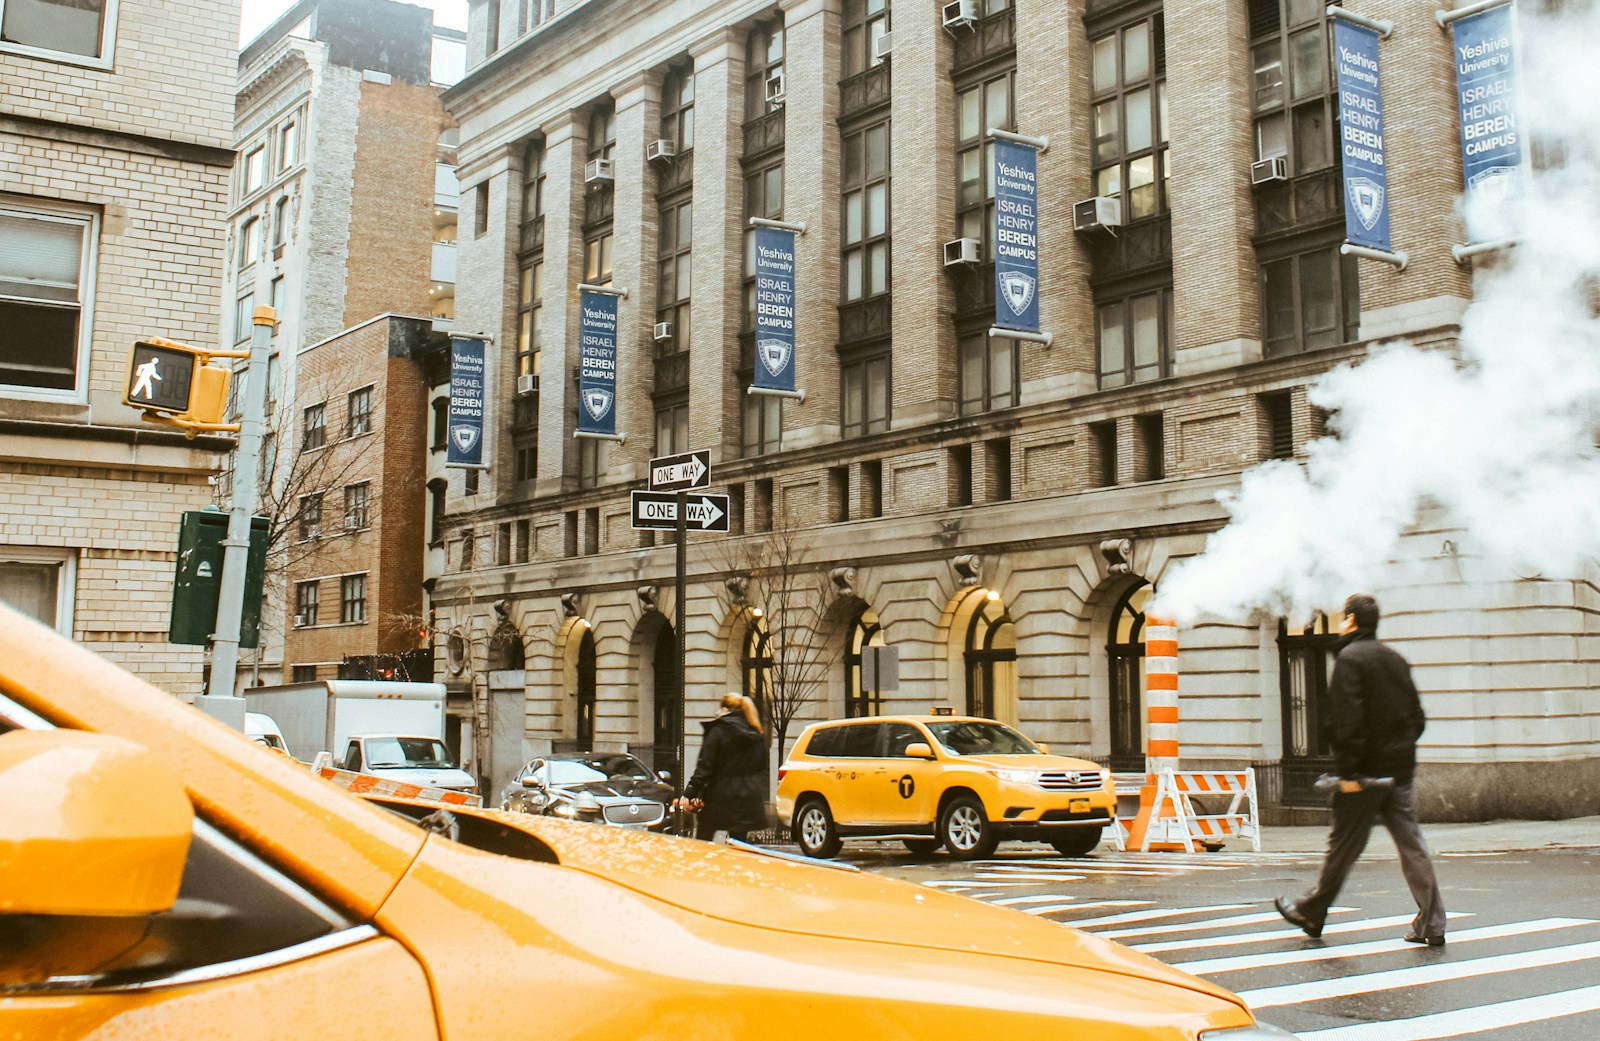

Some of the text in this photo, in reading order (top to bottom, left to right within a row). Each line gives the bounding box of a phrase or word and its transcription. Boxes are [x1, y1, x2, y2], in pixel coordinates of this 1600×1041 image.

[1459, 37, 1509, 60] Yeshiva
[1340, 46, 1378, 71] Yeshiva
[1460, 53, 1509, 74] University
[1340, 64, 1378, 87] University
[1462, 80, 1512, 104] ISRAEL
[1342, 91, 1380, 114] ISRAEL
[1463, 97, 1510, 122] HENRY
[1343, 108, 1379, 130] HENRY
[1465, 114, 1514, 140] BEREN
[1344, 126, 1382, 149] BEREN
[1466, 133, 1516, 156] CAMPUS
[1345, 145, 1383, 165] CAMPUS
[998, 163, 1034, 181] Yeshiva
[998, 177, 1034, 194] University
[998, 200, 1034, 217] ISRAEL
[998, 214, 1034, 231] HENRY
[999, 229, 1035, 247] BEREN
[758, 246, 792, 261] Yeshiva
[999, 245, 1036, 260] CAMPUS
[758, 258, 792, 272] University
[758, 278, 792, 292] ISRAEL
[758, 292, 791, 304] HENRY
[584, 308, 615, 320] Yeshiva
[758, 303, 792, 317] BEREN
[584, 319, 615, 331] University
[758, 317, 792, 328] CAMPUS
[583, 336, 614, 347] ISRAEL
[454, 353, 483, 364] Yeshiva
[583, 348, 613, 357] HENRY
[453, 363, 482, 372] University
[583, 358, 614, 370] BEREN
[583, 369, 614, 379] CAMPUS
[452, 378, 482, 388] ISRAEL
[452, 388, 481, 397] HENRY
[452, 398, 481, 407] BEREN
[451, 408, 481, 416] CAMPUS
[657, 463, 700, 482] ONE WAY
[647, 504, 714, 519] ONE WAY
[902, 779, 912, 796] T
